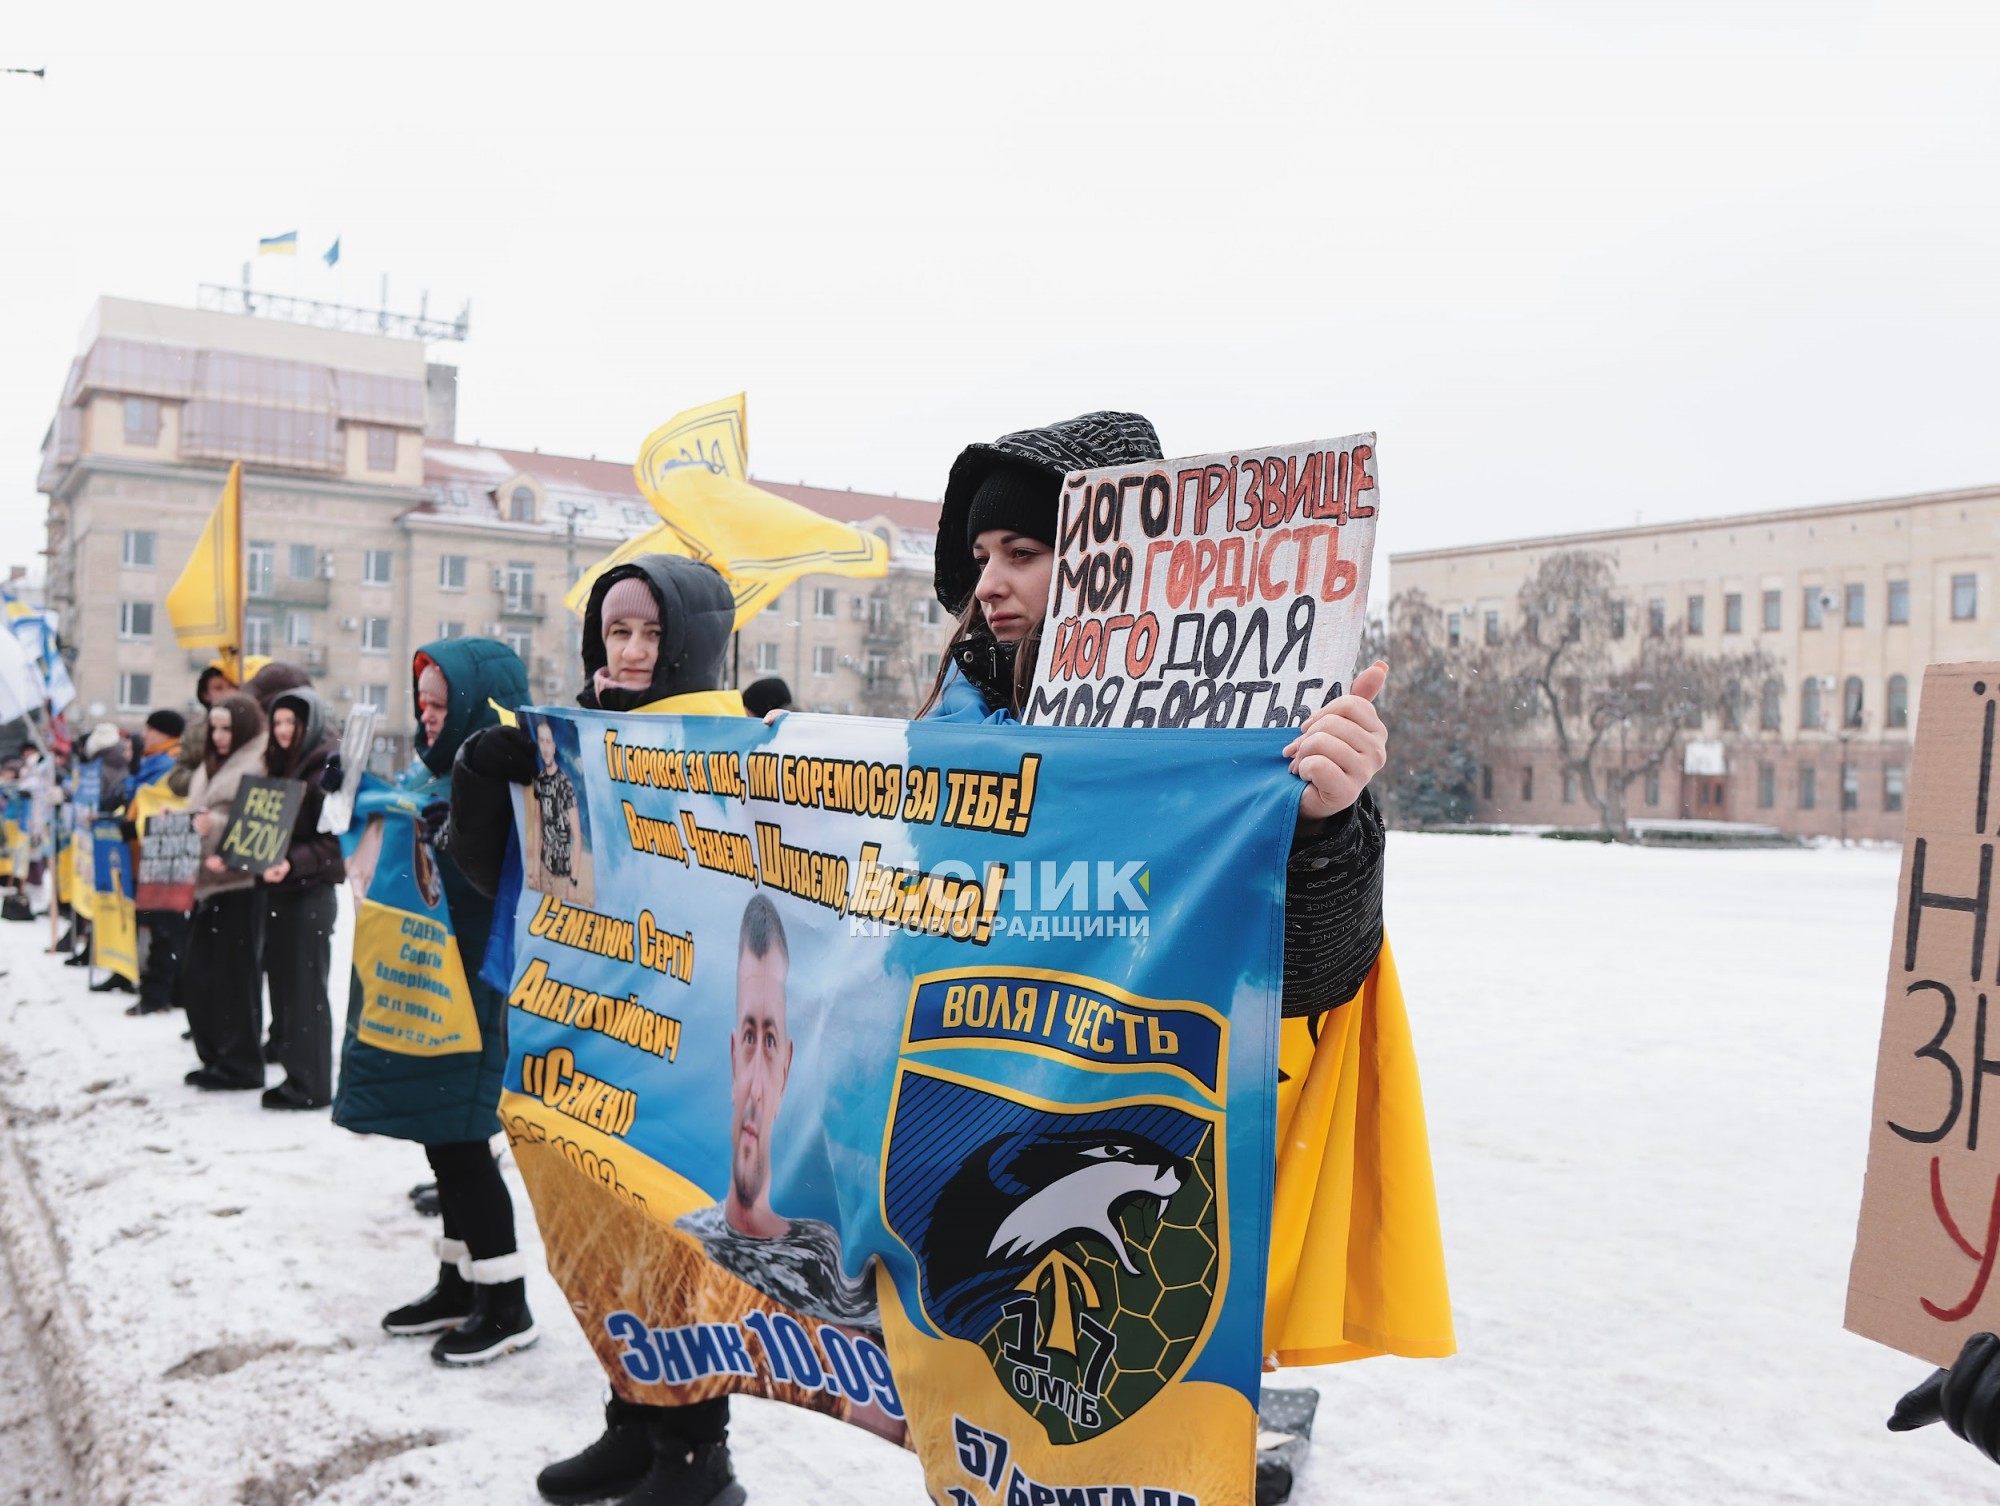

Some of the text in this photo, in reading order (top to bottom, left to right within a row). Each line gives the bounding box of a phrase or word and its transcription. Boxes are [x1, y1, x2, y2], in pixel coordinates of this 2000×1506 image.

[1058, 445, 1376, 557] ЙОГО ПРІЗВИЩЕ
[1053, 523, 1358, 617] МОЯ ГОРДІСТЬ
[1049, 594, 1316, 682] ЙОГО ДОЛЯ
[1026, 675, 1124, 728] МОЯ
[243, 787, 285, 822] FREE
[625, 745, 688, 792] БОРОВСЯ
[685, 750, 710, 794] ЗА
[707, 751, 746, 805] НАС,
[747, 752, 780, 803] МИ
[781, 755, 902, 820] БОРЕМОСЯ
[902, 765, 940, 825] ЗА
[940, 753, 1042, 837] ТЕБЕ!
[222, 819, 288, 863] AZOV
[942, 984, 1180, 1056] ВОЛЯ І ЧЕСТЬ
[1012, 1366, 1102, 1429] ОМПБ
[952, 1412, 1010, 1494] 57
